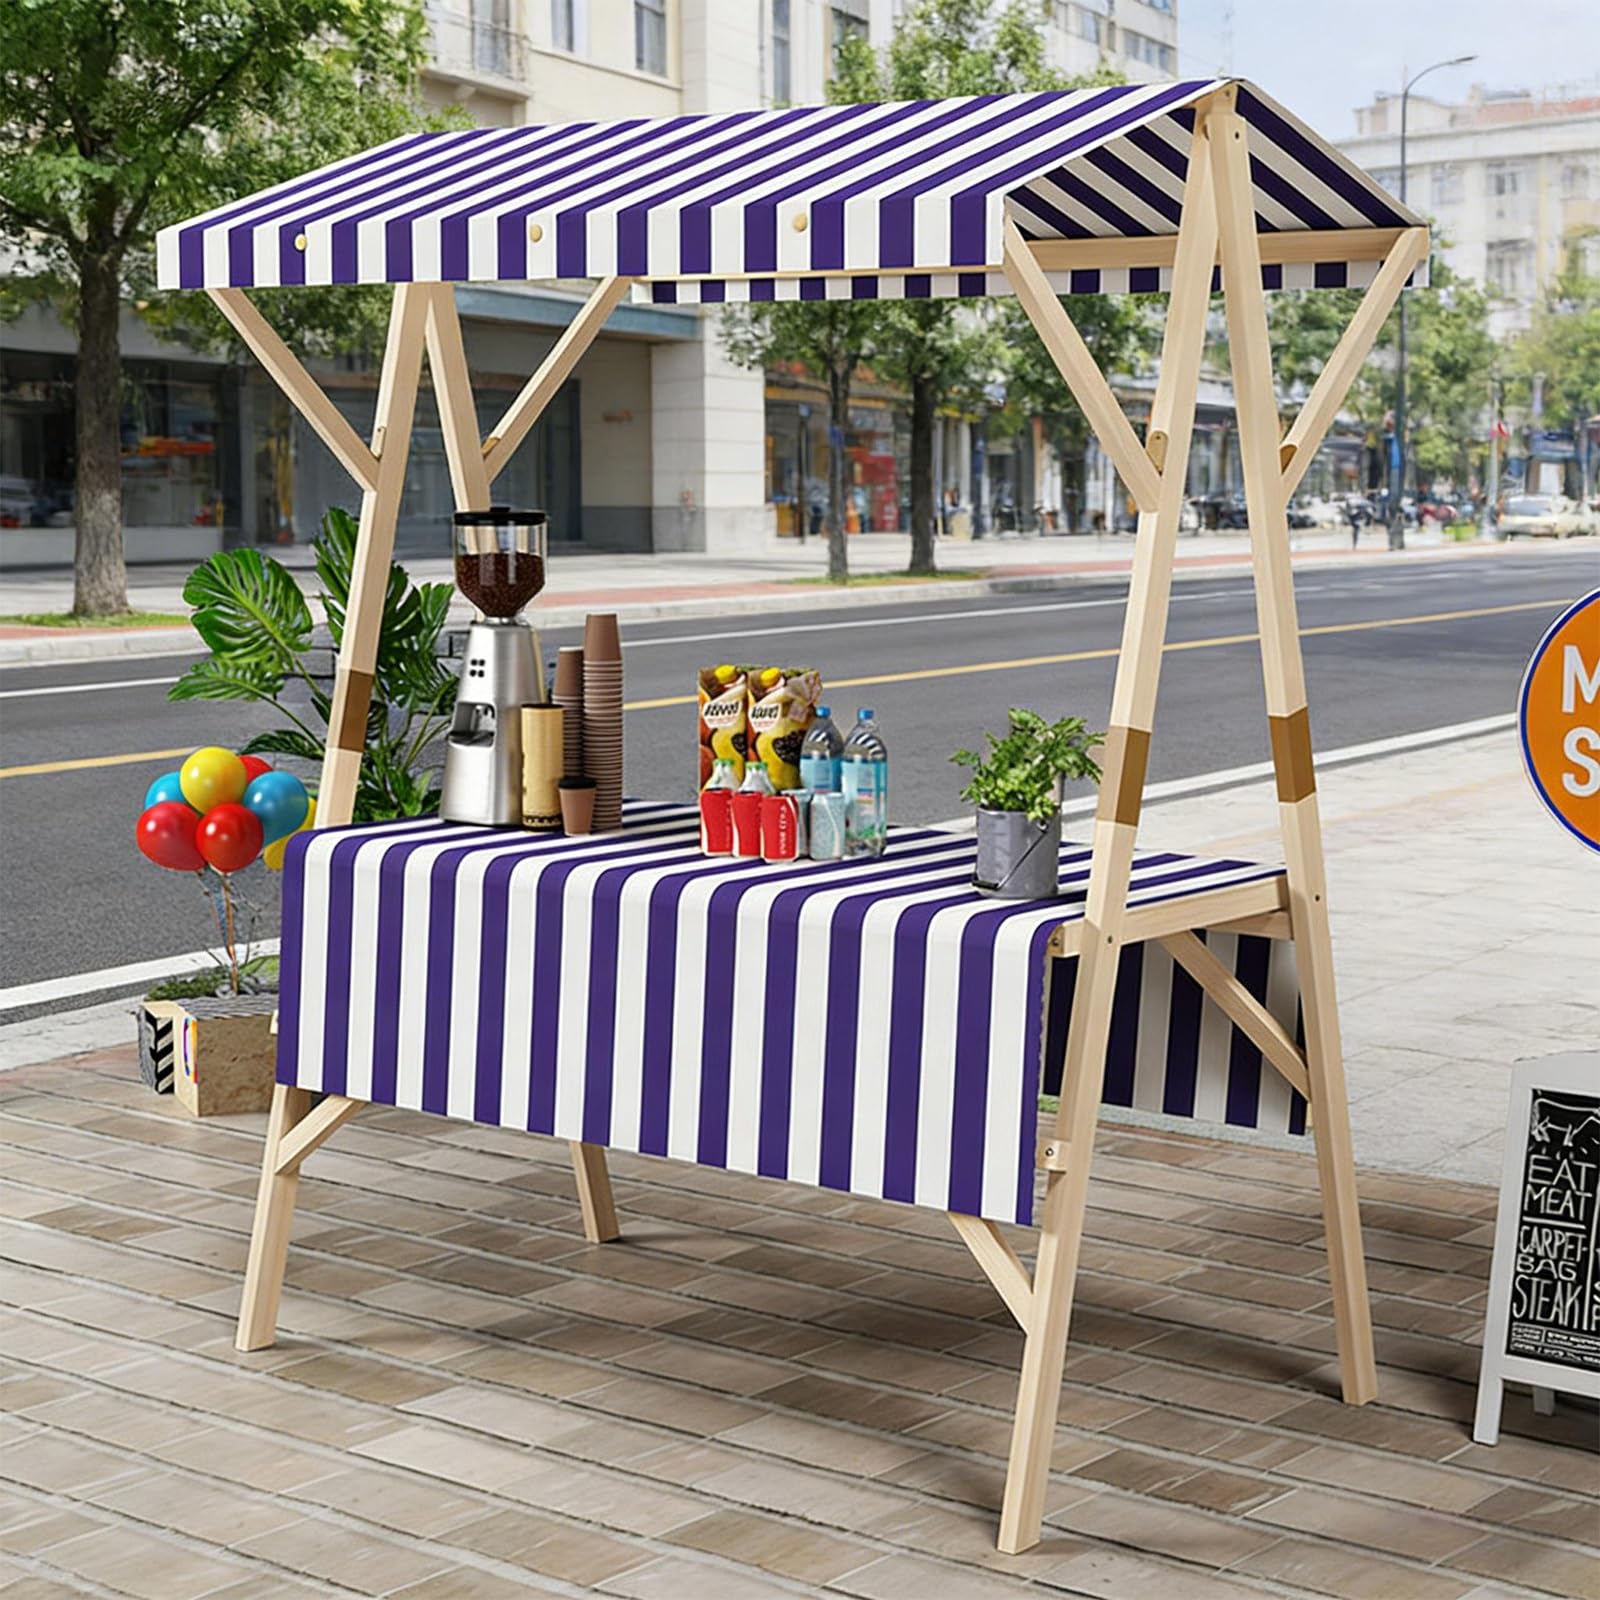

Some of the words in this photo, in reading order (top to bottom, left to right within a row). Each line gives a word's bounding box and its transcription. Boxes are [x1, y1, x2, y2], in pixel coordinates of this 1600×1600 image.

[1528, 1154, 1597, 1190] EAT
[1523, 1184, 1593, 1221] MEAT
[1516, 1253, 1577, 1281] BAG
[1511, 1274, 1583, 1329] STEAK
